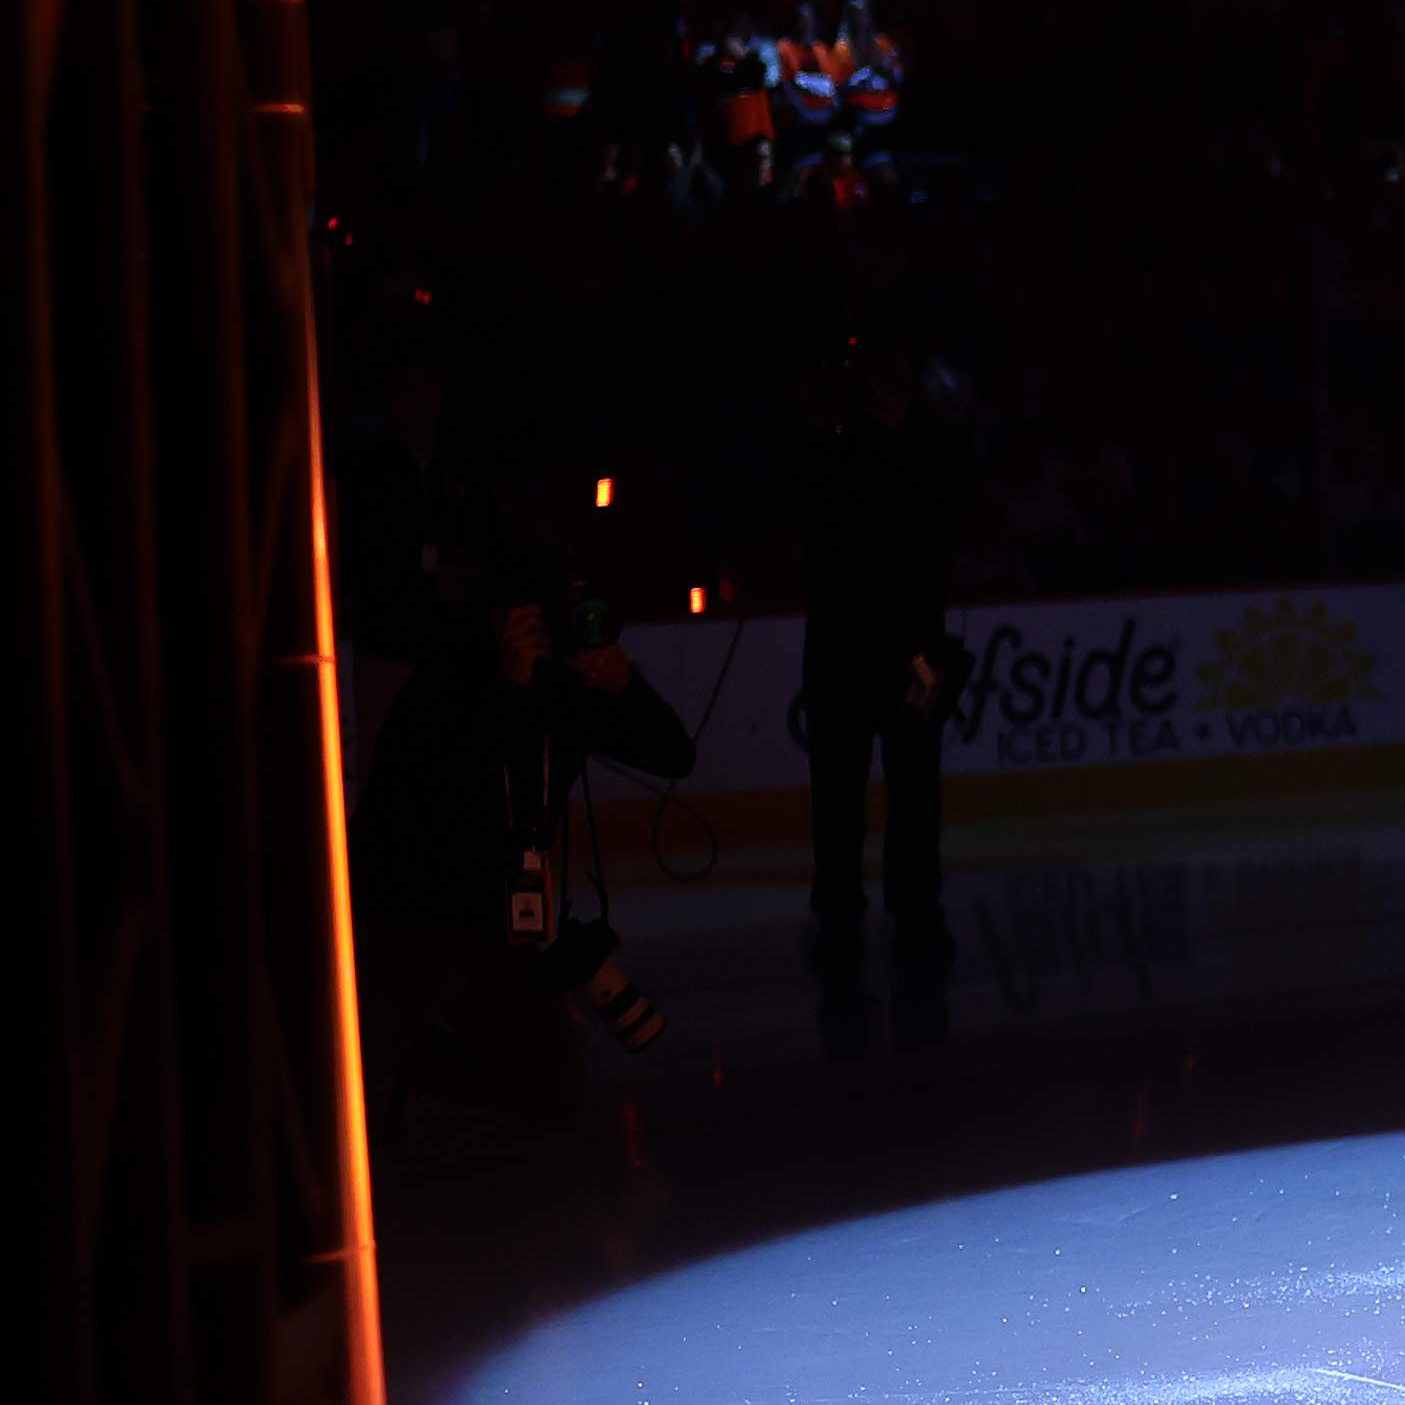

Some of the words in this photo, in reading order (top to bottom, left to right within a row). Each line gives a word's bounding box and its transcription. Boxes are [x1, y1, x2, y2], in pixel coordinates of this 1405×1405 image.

[999, 721, 1085, 764] ICED
[1106, 712, 1178, 755] TEA
[1225, 706, 1356, 747] VODKA
